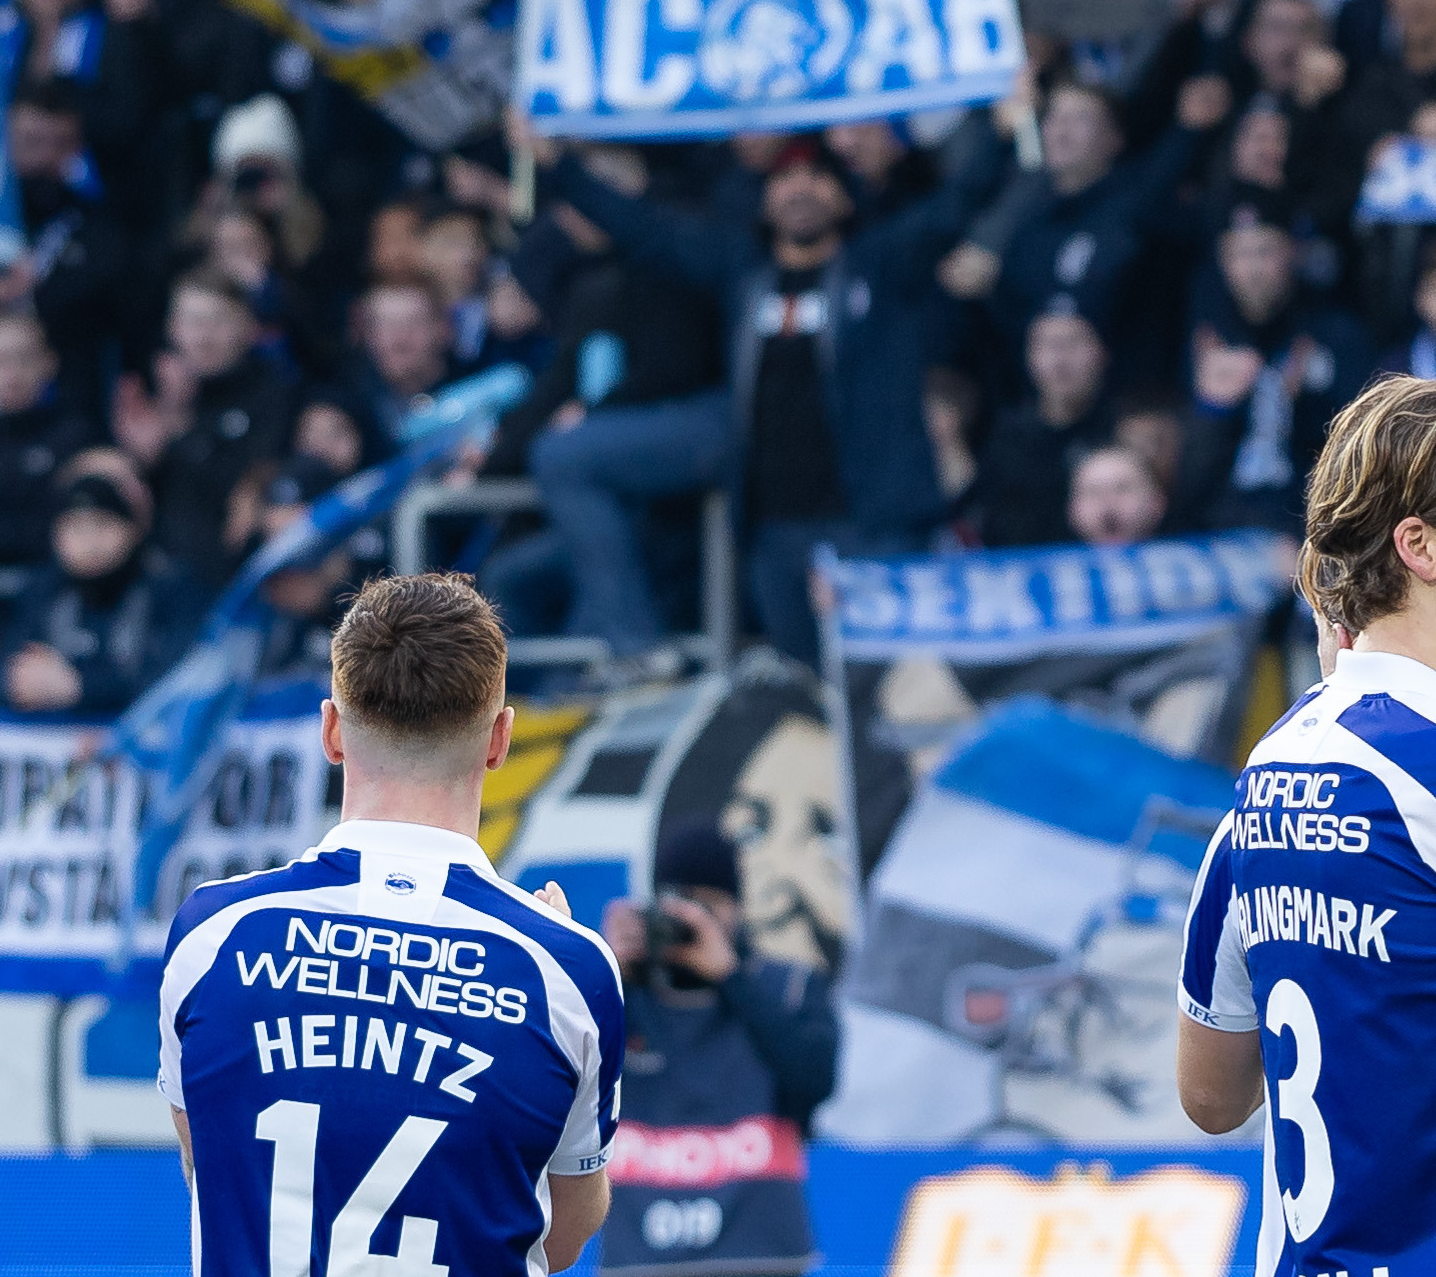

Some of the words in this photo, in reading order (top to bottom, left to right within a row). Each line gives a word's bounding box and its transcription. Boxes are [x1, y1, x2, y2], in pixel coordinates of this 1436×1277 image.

[1243, 771, 1340, 809] NORDIC
[1231, 812, 1371, 853] WELLNESS
[285, 917, 486, 978] NORDIC
[1238, 885, 1398, 963] RLINGMARK
[236, 952, 528, 1025] WELLNESS
[1187, 1001, 1220, 1026] IFK
[254, 1015, 495, 1103] HEINTZ
[1266, 978, 1335, 1244] 3
